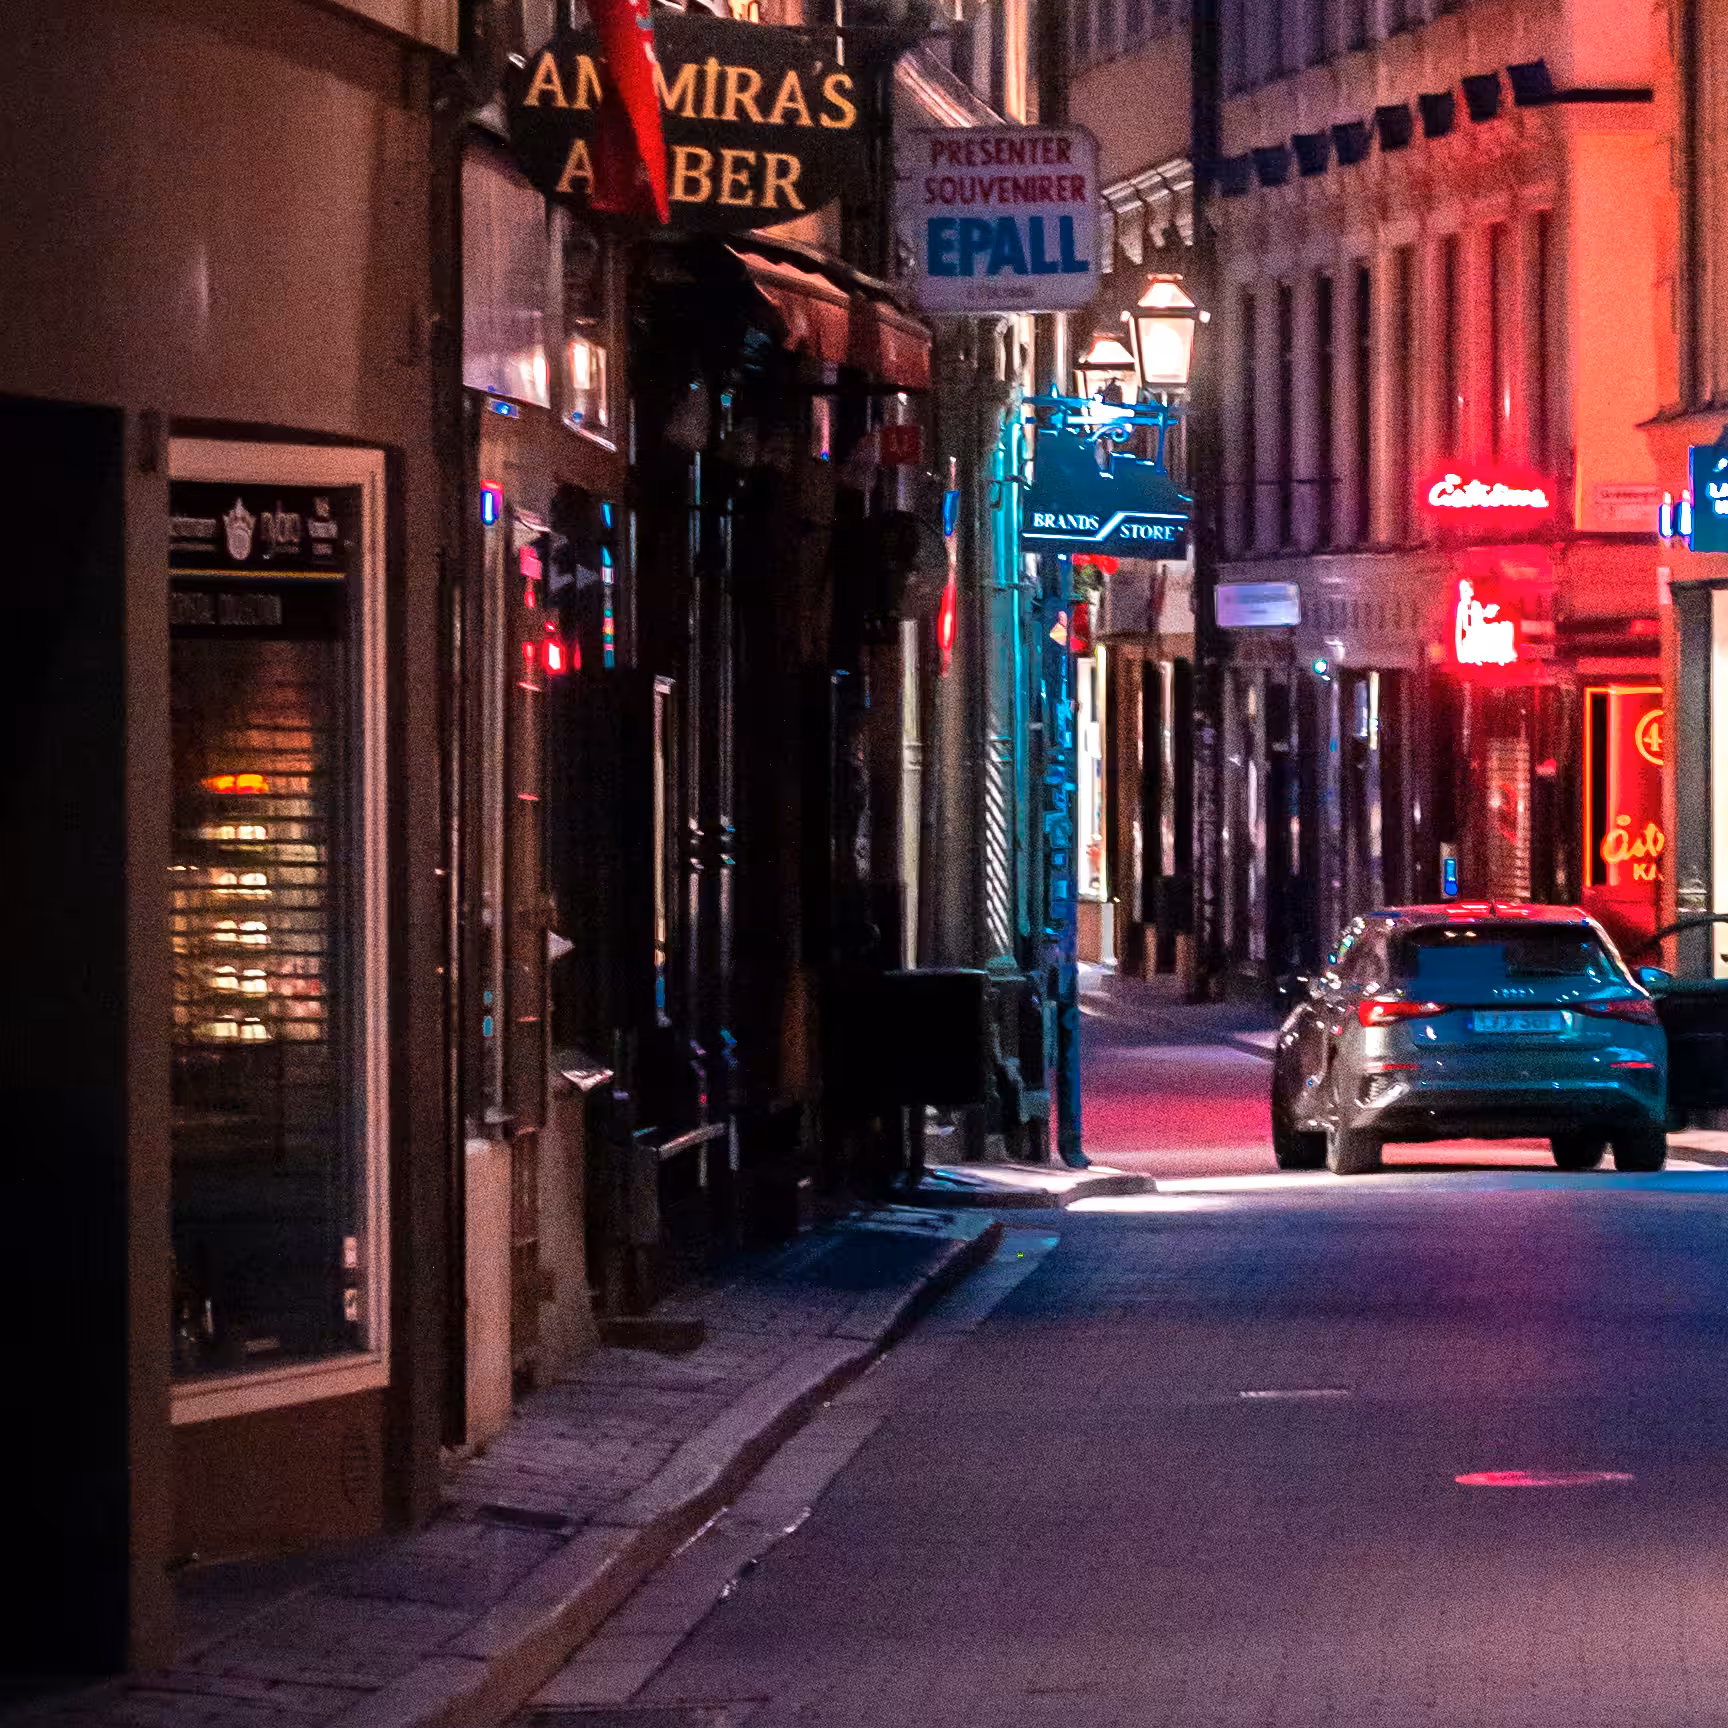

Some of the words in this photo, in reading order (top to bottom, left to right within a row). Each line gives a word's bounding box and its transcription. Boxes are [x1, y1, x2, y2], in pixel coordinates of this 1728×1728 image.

[930, 137, 1072, 166] PRESENTER
[556, 138, 805, 210] ABER
[924, 175, 1087, 205] SOUVENIRER
[927, 215, 1089, 276] EPALL
[1032, 511, 1101, 531] BRANDS
